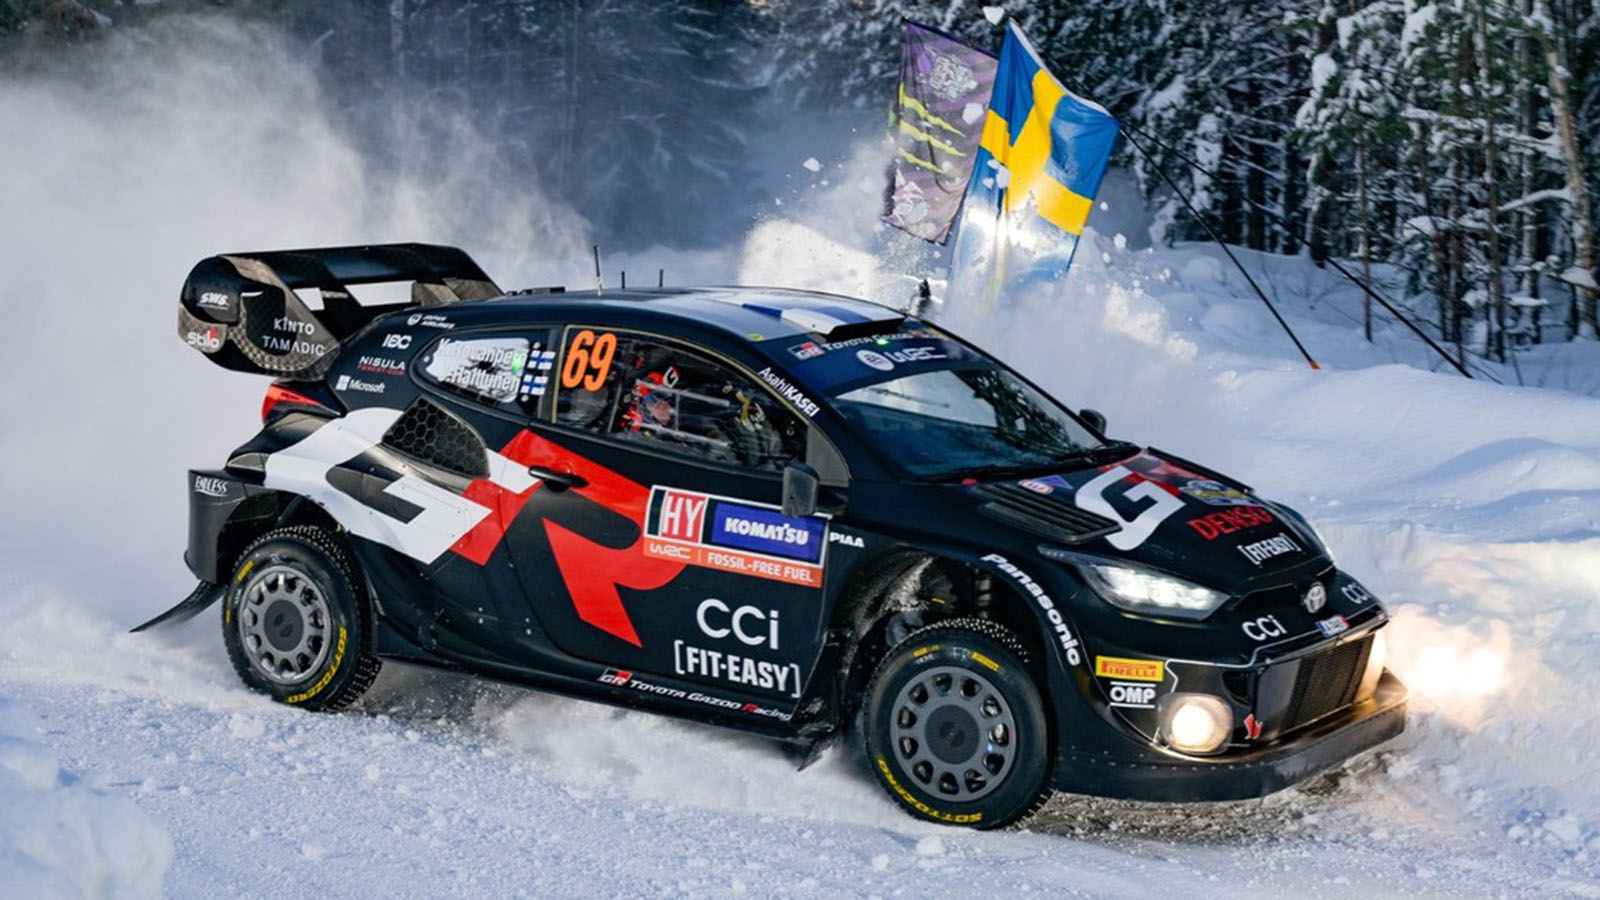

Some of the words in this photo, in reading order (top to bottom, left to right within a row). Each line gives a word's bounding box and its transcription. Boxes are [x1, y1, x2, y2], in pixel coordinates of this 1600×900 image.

[274, 317, 315, 336] KINTO
[263, 336, 325, 356] TAMADIC
[884, 347, 947, 363] WRC
[359, 355, 406, 371] NISULA
[562, 330, 618, 392] 69
[349, 378, 386, 393] Microsoft
[758, 367, 820, 417] AsahiKASEI
[662, 496, 704, 538] HY
[1187, 506, 1273, 541] DENSO
[725, 517, 810, 546] KOMATSU
[829, 532, 865, 549] PIAA
[650, 542, 692, 559] WRC
[707, 552, 782, 578] FOSSIL-FREE
[784, 567, 813, 583] FUEL
[980, 553, 1080, 666] Panasonic
[696, 598, 779, 650] CCi
[1242, 614, 1287, 641] CCi
[1101, 659, 1156, 678] PIRELLI
[630, 679, 685, 700] TOYOTA
[687, 692, 742, 710] GAZOO
[741, 702, 792, 722] Racing
[1110, 686, 1156, 703] OMP
